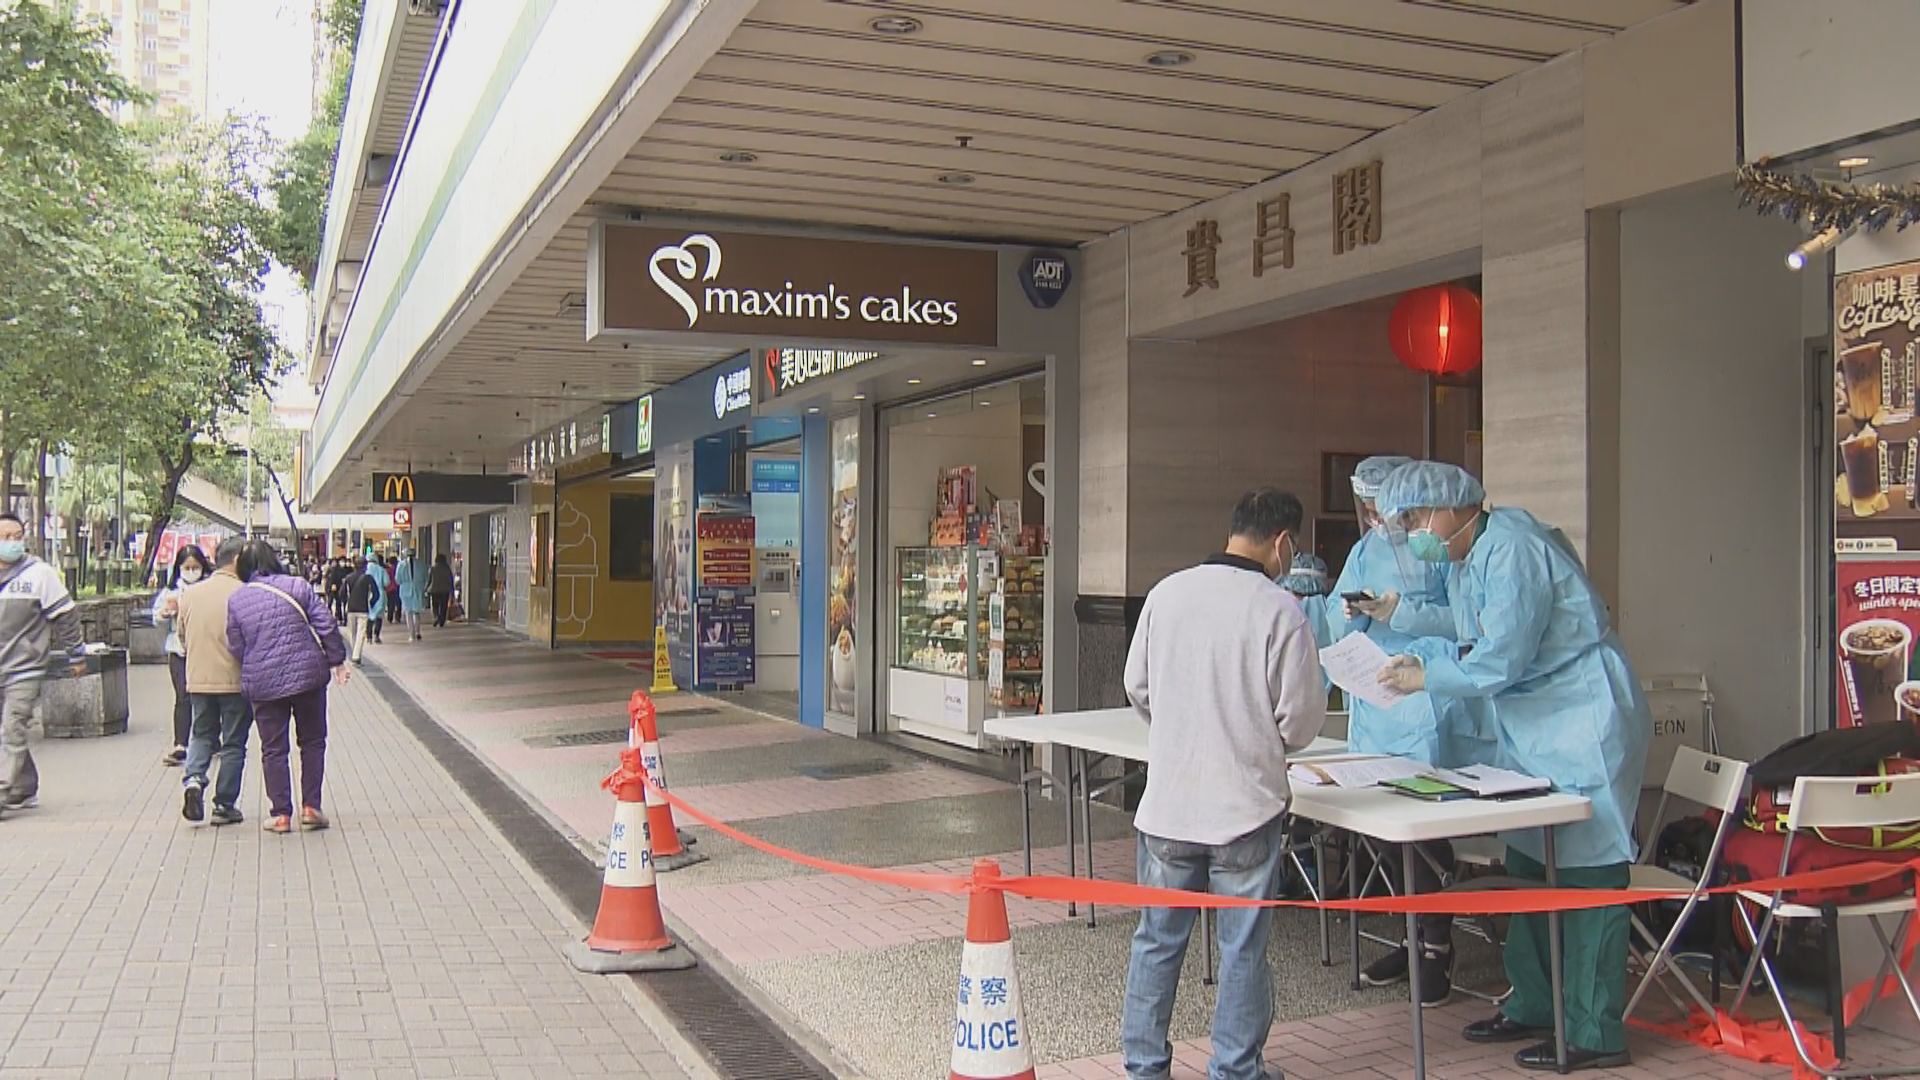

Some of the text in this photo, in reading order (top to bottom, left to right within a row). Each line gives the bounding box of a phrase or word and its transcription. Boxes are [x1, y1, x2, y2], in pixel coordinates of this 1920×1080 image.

[1035, 261, 1063, 280] ADT
[704, 281, 959, 326] maxim's cakes
[1859, 596, 1897, 611] winter
